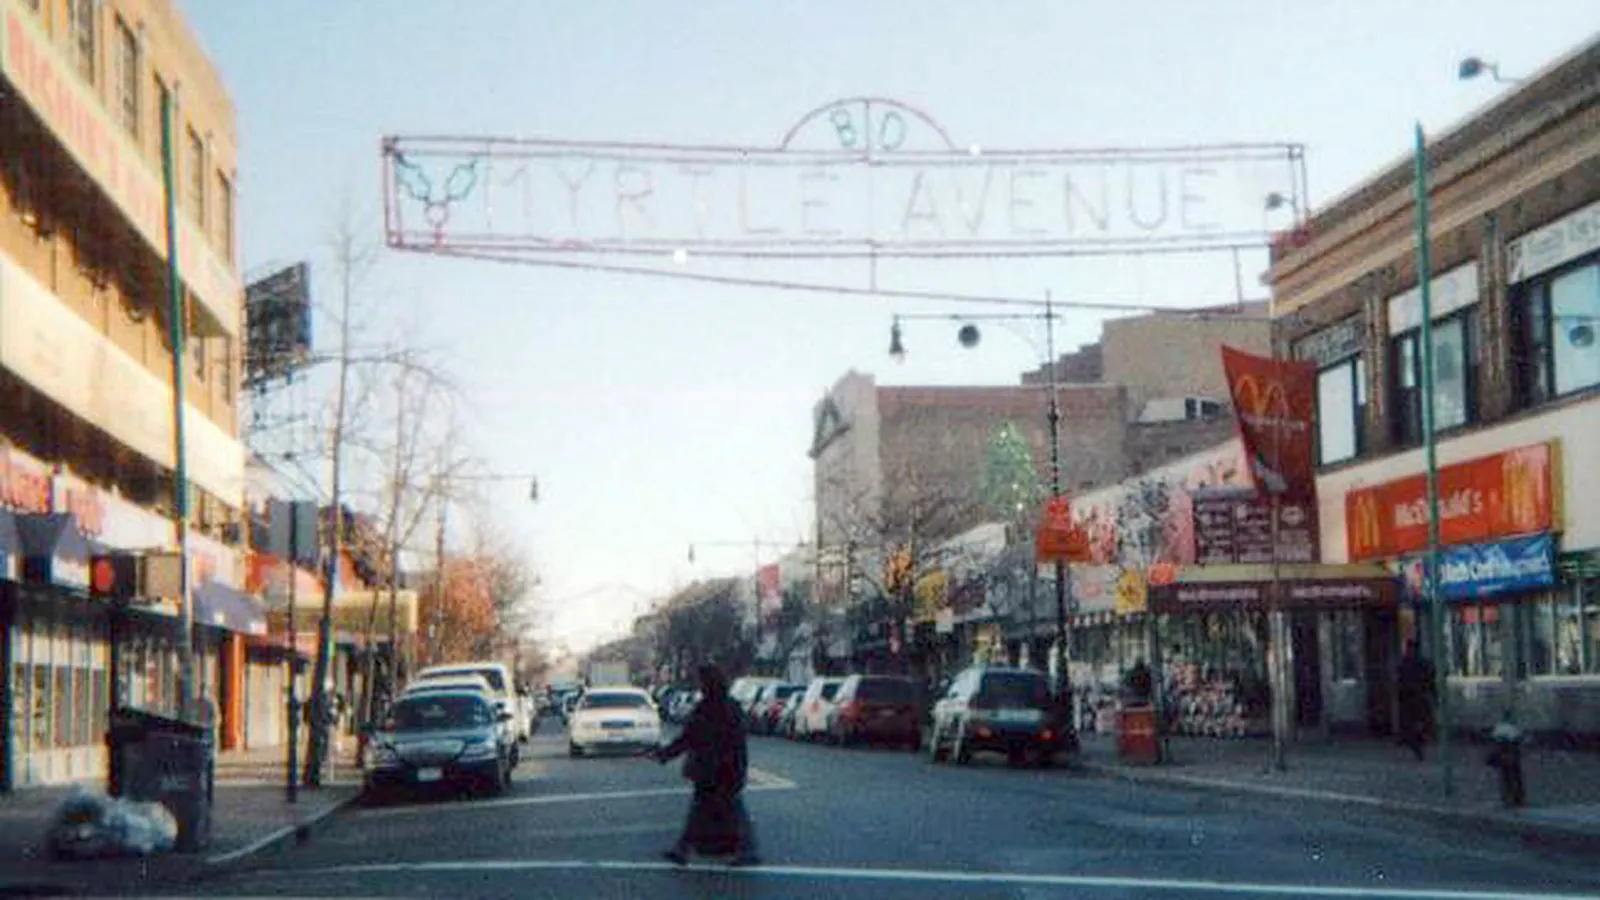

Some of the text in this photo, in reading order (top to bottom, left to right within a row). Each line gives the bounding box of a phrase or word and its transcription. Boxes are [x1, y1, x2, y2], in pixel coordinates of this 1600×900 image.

[487, 160, 1220, 240] MYRTLE AVENUE
[1394, 487, 1483, 526] McDnald's
